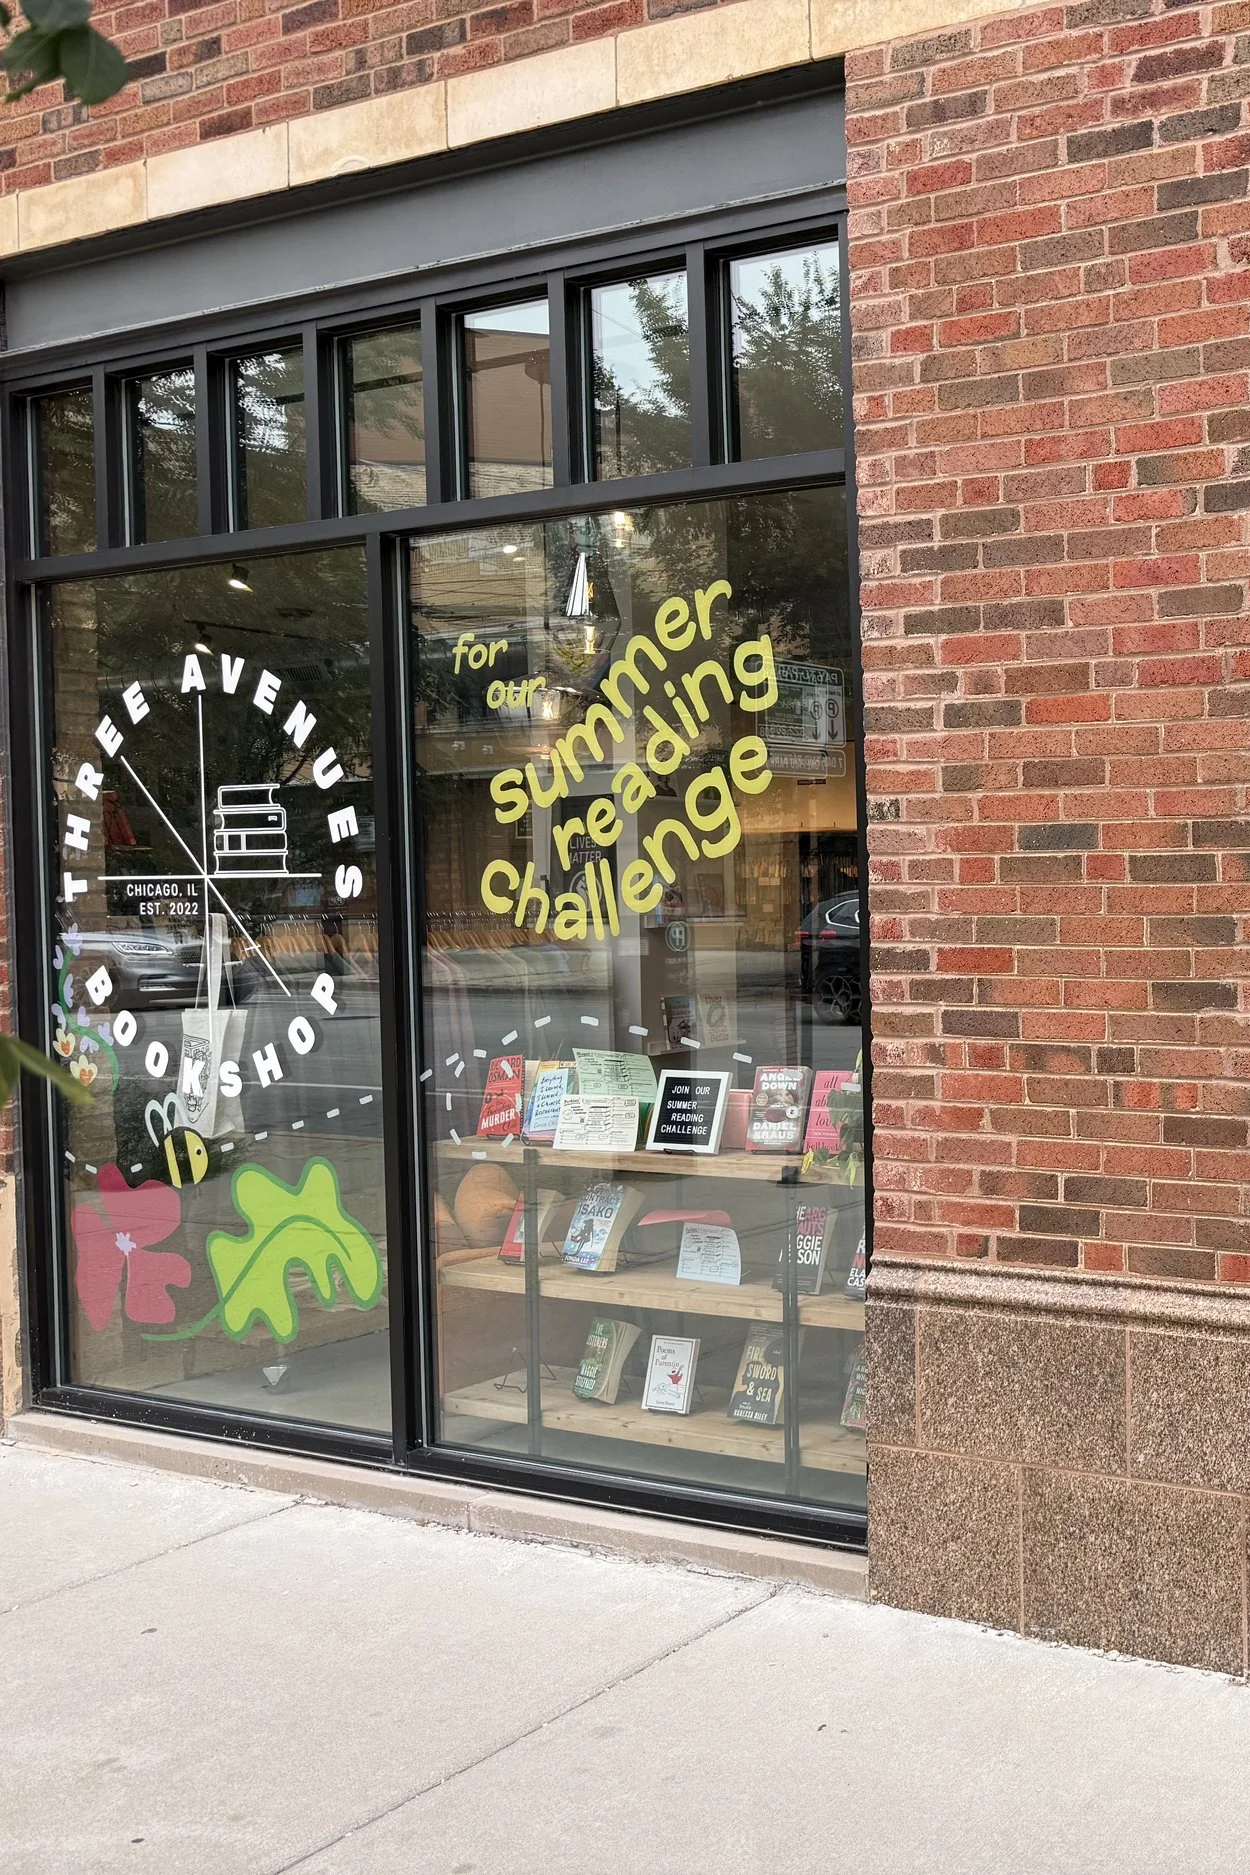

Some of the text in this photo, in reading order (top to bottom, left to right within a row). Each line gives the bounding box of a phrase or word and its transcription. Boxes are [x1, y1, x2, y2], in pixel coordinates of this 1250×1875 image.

[452, 632, 508, 674] for
[486, 675, 546, 710] our
[490, 579, 732, 824] summer
[553, 634, 779, 871] reading
[63, 653, 364, 903] THREE AVENUES
[570, 837, 597, 849] LIVES
[569, 850, 601, 865] ATTER
[126, 883, 199, 899] CHICAGO, IL
[139, 902, 199, 916] EST. 2022
[84, 965, 342, 1099] BOOKSHOP
[760, 1073, 803, 1082] ANG
[823, 1076, 838, 1089] all
[672, 1085, 711, 1095] JOIN OUR
[761, 1082, 797, 1090] DOWN
[667, 1100, 698, 1110] SUMMER
[481, 1108, 516, 1130] MURDER
[671, 1113, 704, 1122] READING
[815, 1114, 832, 1127] lov
[661, 1124, 708, 1135] CHALLENGE
[752, 1122, 797, 1130] DANIEL
[752, 1131, 795, 1140] KRAUS
[821, 1141, 840, 1151] hook
[577, 1203, 614, 1219] ISAKO
[797, 1221, 825, 1235] AUTS
[796, 1235, 822, 1250] GGIE
[849, 1268, 866, 1277] ELA
[847, 1277, 866, 1287] CAS
[657, 1345, 676, 1354] Poems
[747, 1363, 777, 1381] SWORD
[746, 1381, 772, 1403] & SEA
